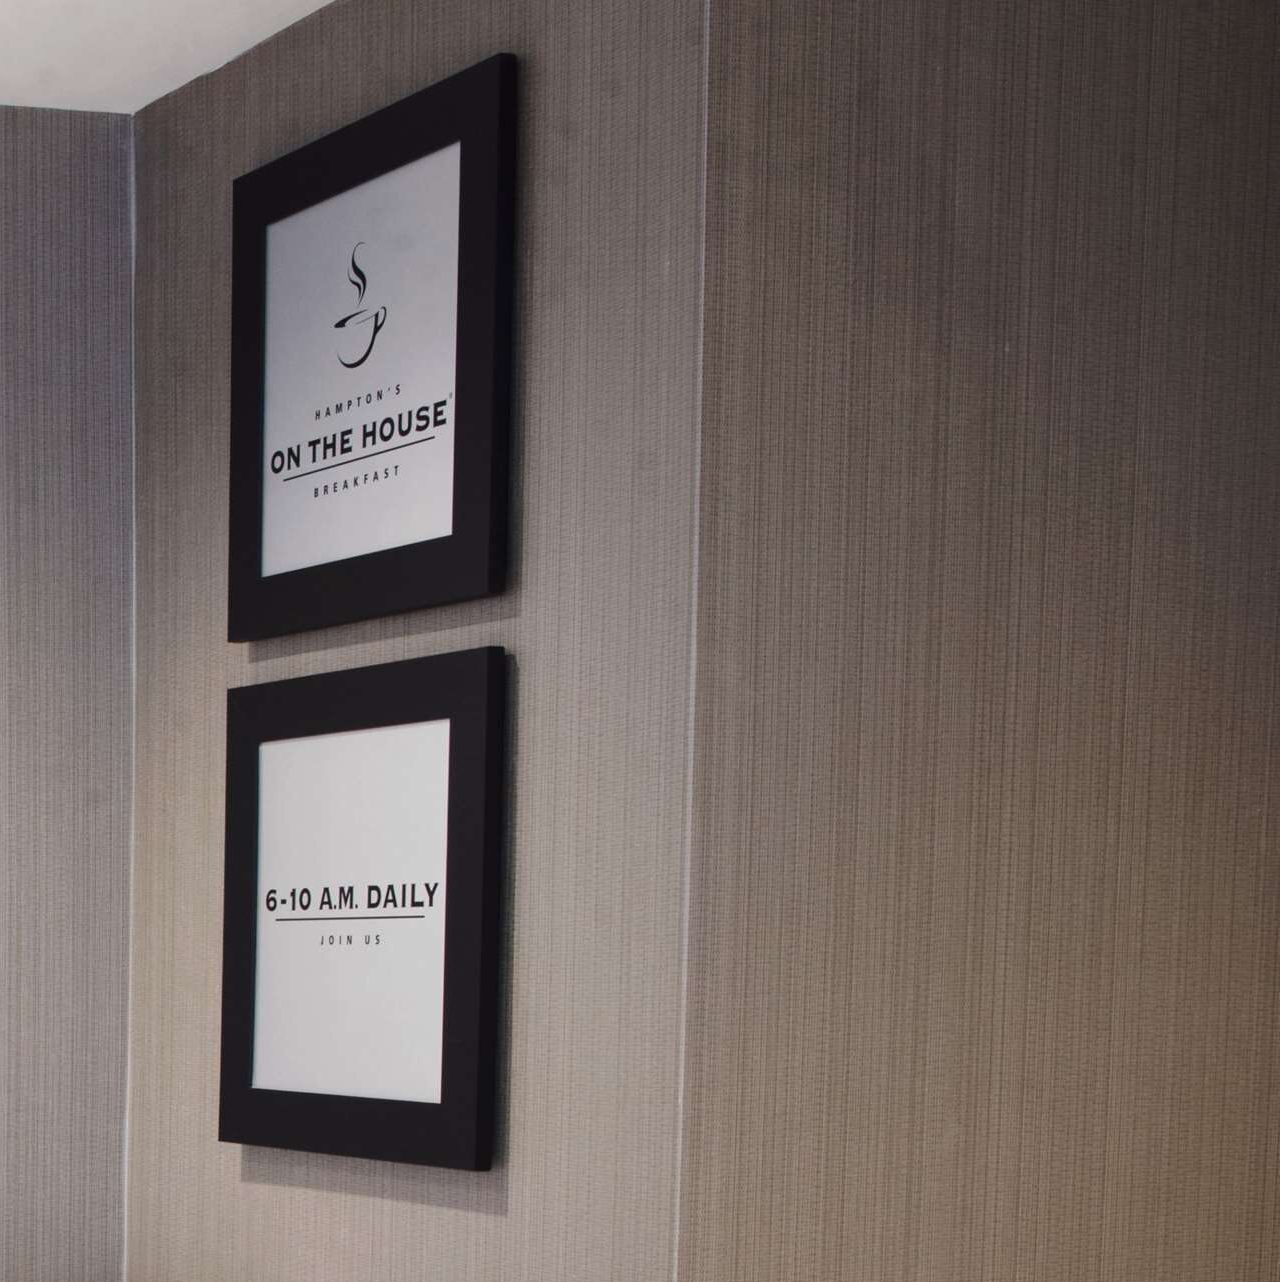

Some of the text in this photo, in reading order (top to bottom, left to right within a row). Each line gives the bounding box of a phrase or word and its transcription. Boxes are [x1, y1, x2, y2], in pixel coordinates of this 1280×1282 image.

[314, 384, 402, 421] HAMPTON'S
[270, 399, 448, 474] ON THE HOUSE
[313, 465, 401, 498] BREAKFAST
[265, 882, 439, 912] 6-10 A.M. DAILY
[320, 934, 381, 946] JOIN US
